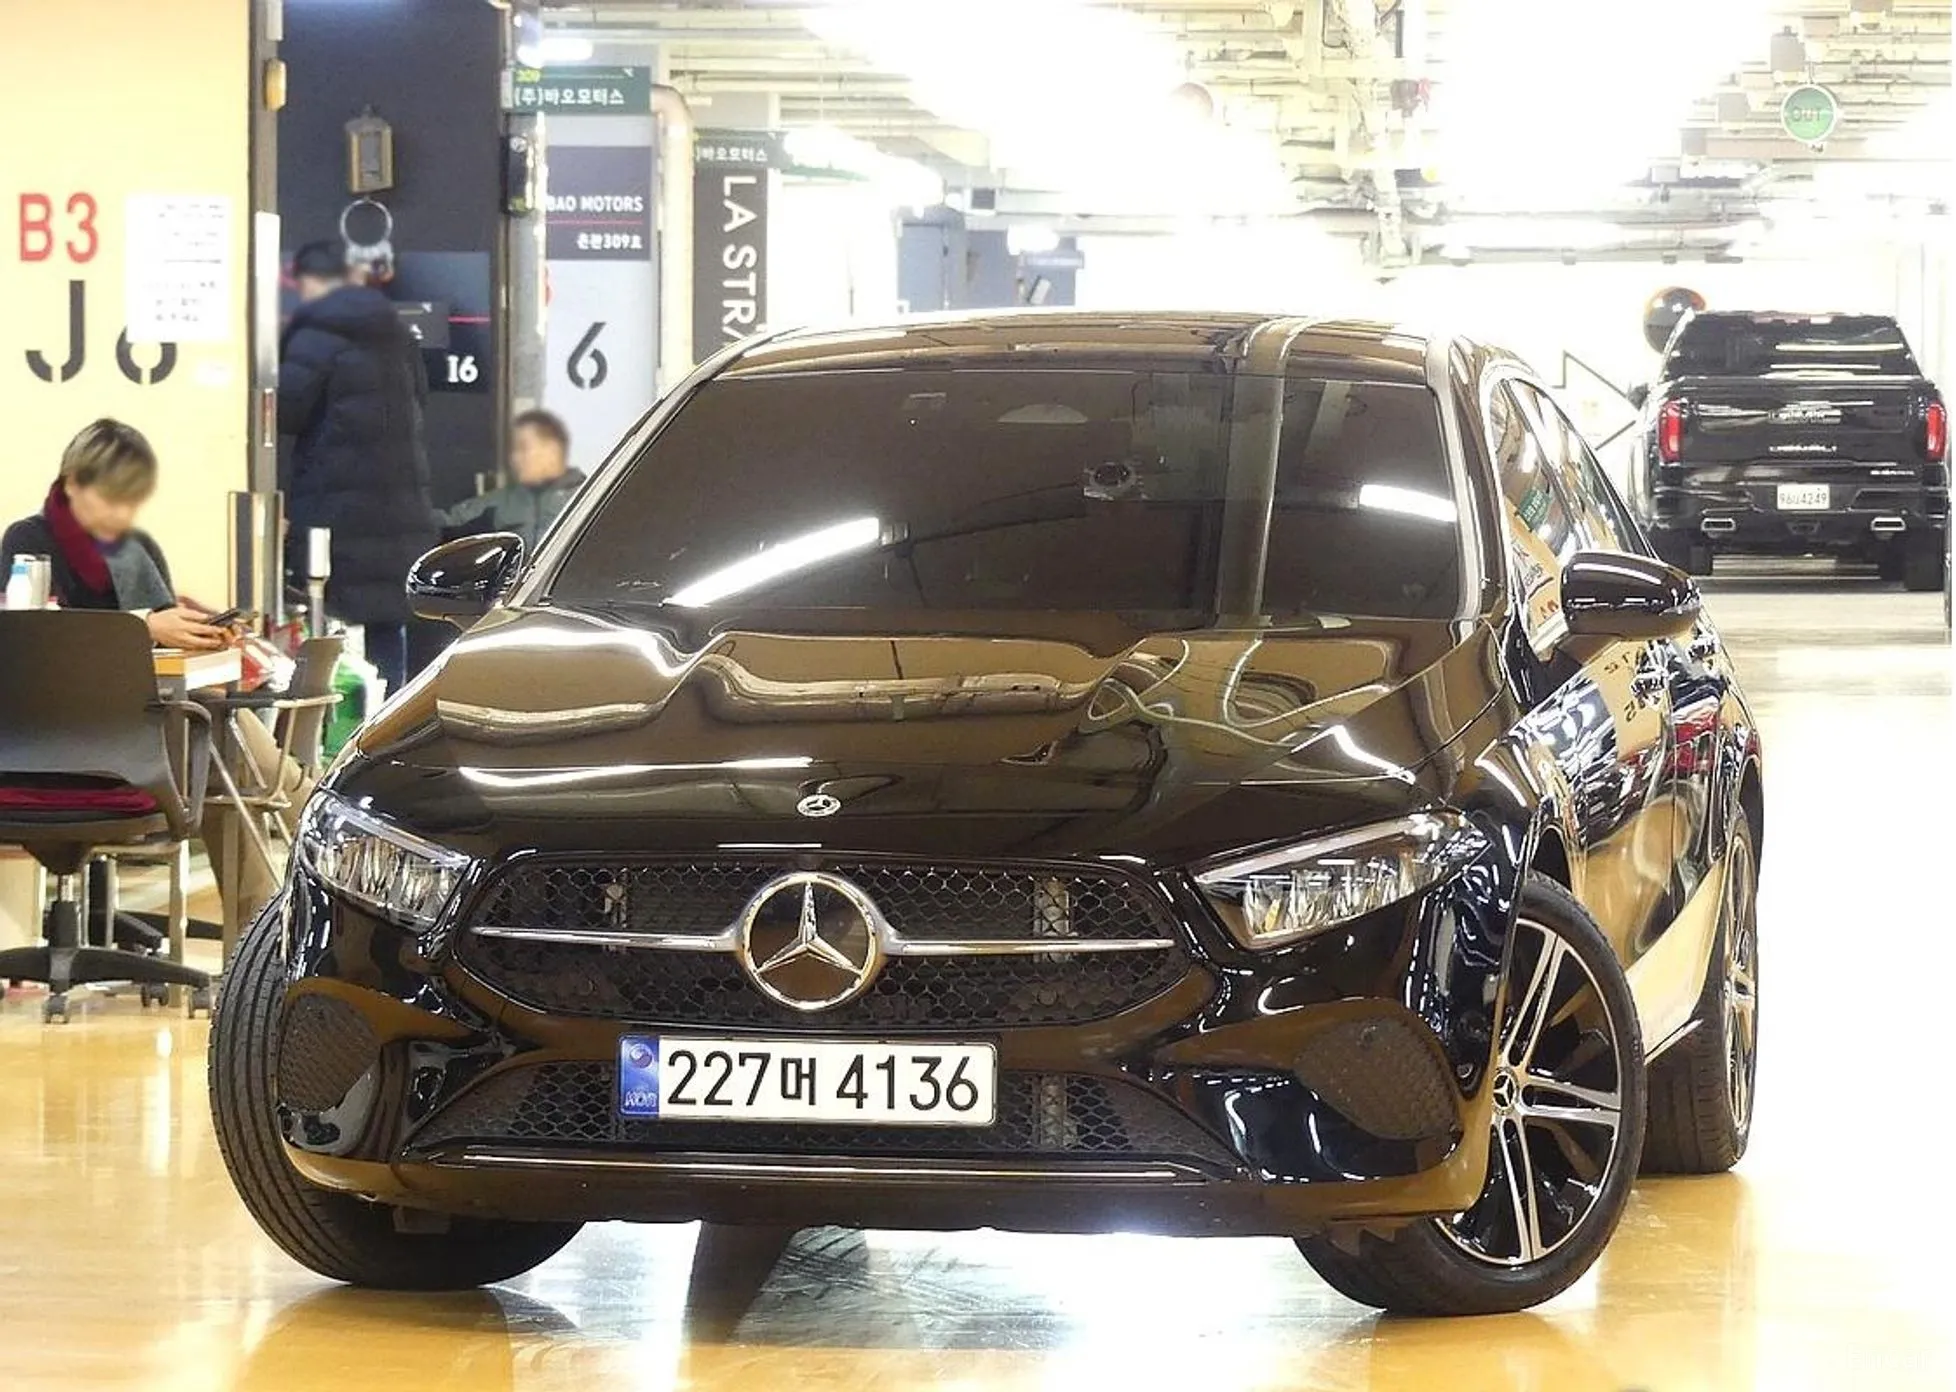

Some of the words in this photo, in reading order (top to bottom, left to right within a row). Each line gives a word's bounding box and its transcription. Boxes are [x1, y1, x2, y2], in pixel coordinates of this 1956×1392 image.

[514, 87, 625, 106] (주)바오모터스
[1792, 107, 1822, 121] OUT
[19, 192, 99, 264] B3
[580, 195, 644, 212] MOTORS
[722, 175, 758, 233] LA
[566, 321, 608, 389] 6
[667, 1050, 816, 1106] 227머
[836, 1054, 980, 1111] 4136
